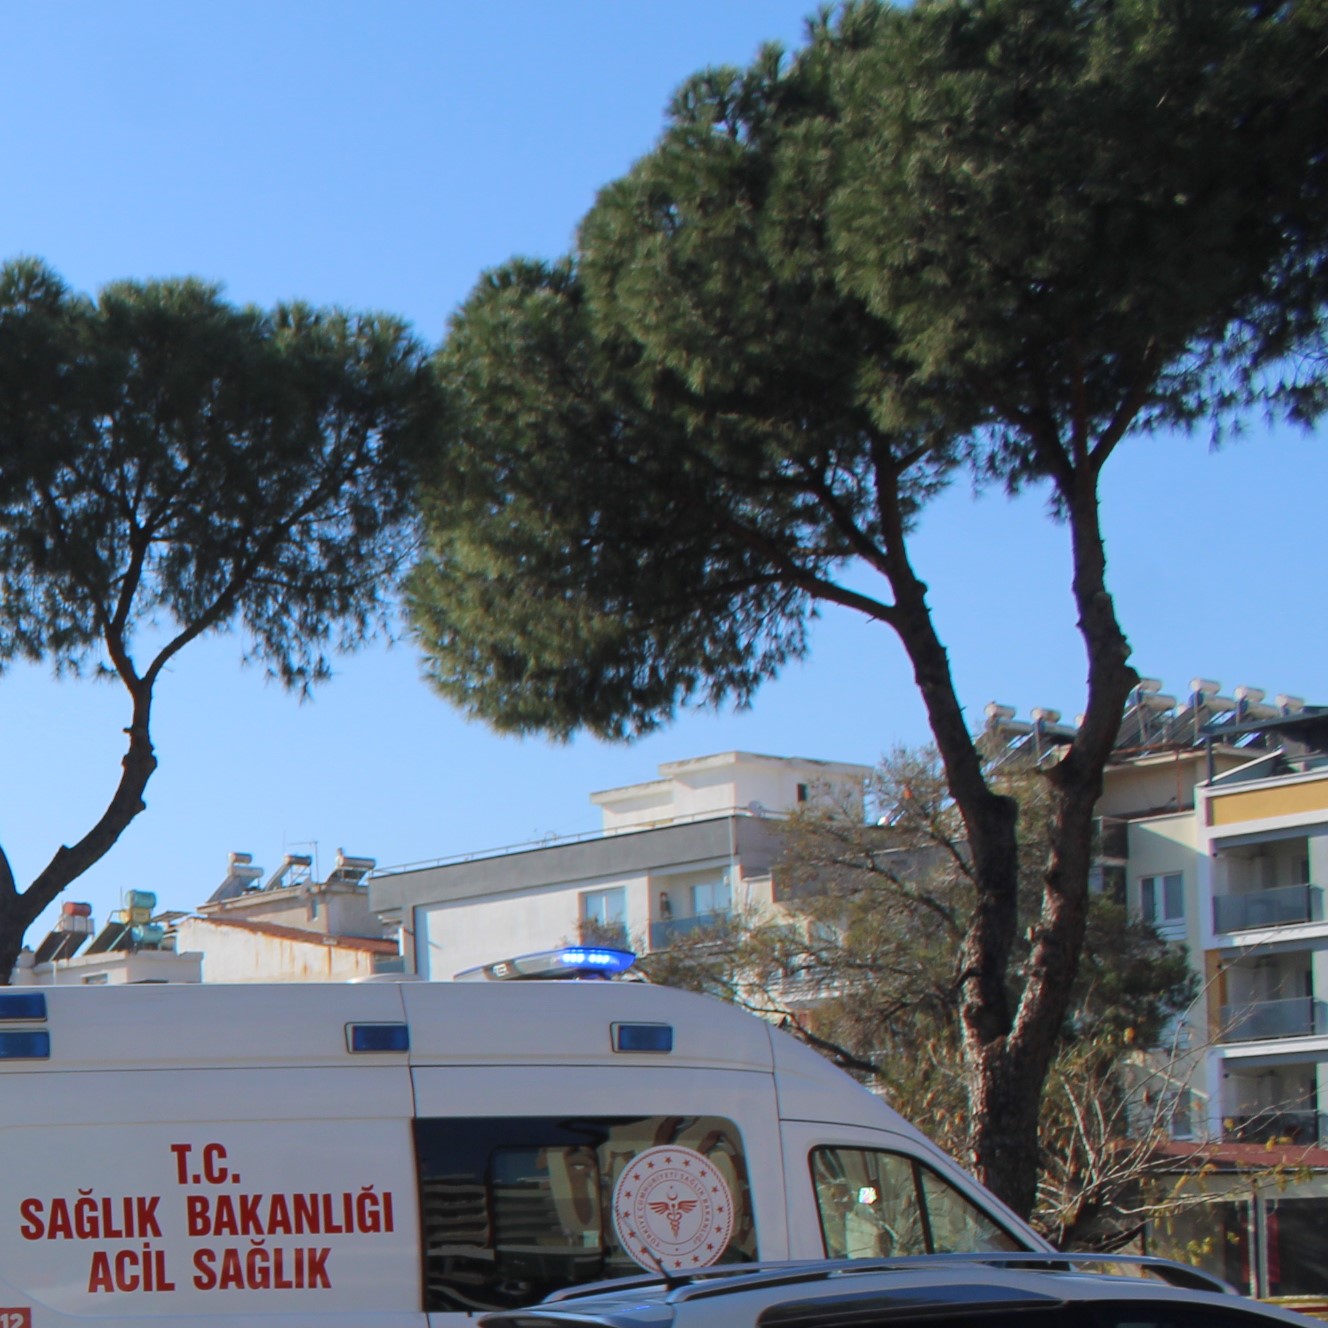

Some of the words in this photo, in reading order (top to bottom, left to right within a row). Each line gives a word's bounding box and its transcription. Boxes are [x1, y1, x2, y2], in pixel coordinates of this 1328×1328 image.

[171, 1143, 241, 1184] T.C.
[20, 1188, 162, 1240] SAĞLIK
[187, 1185, 394, 1237] BAKANLIĞI
[88, 1242, 175, 1293] ACİL
[192, 1239, 332, 1291] SAĞLIK
